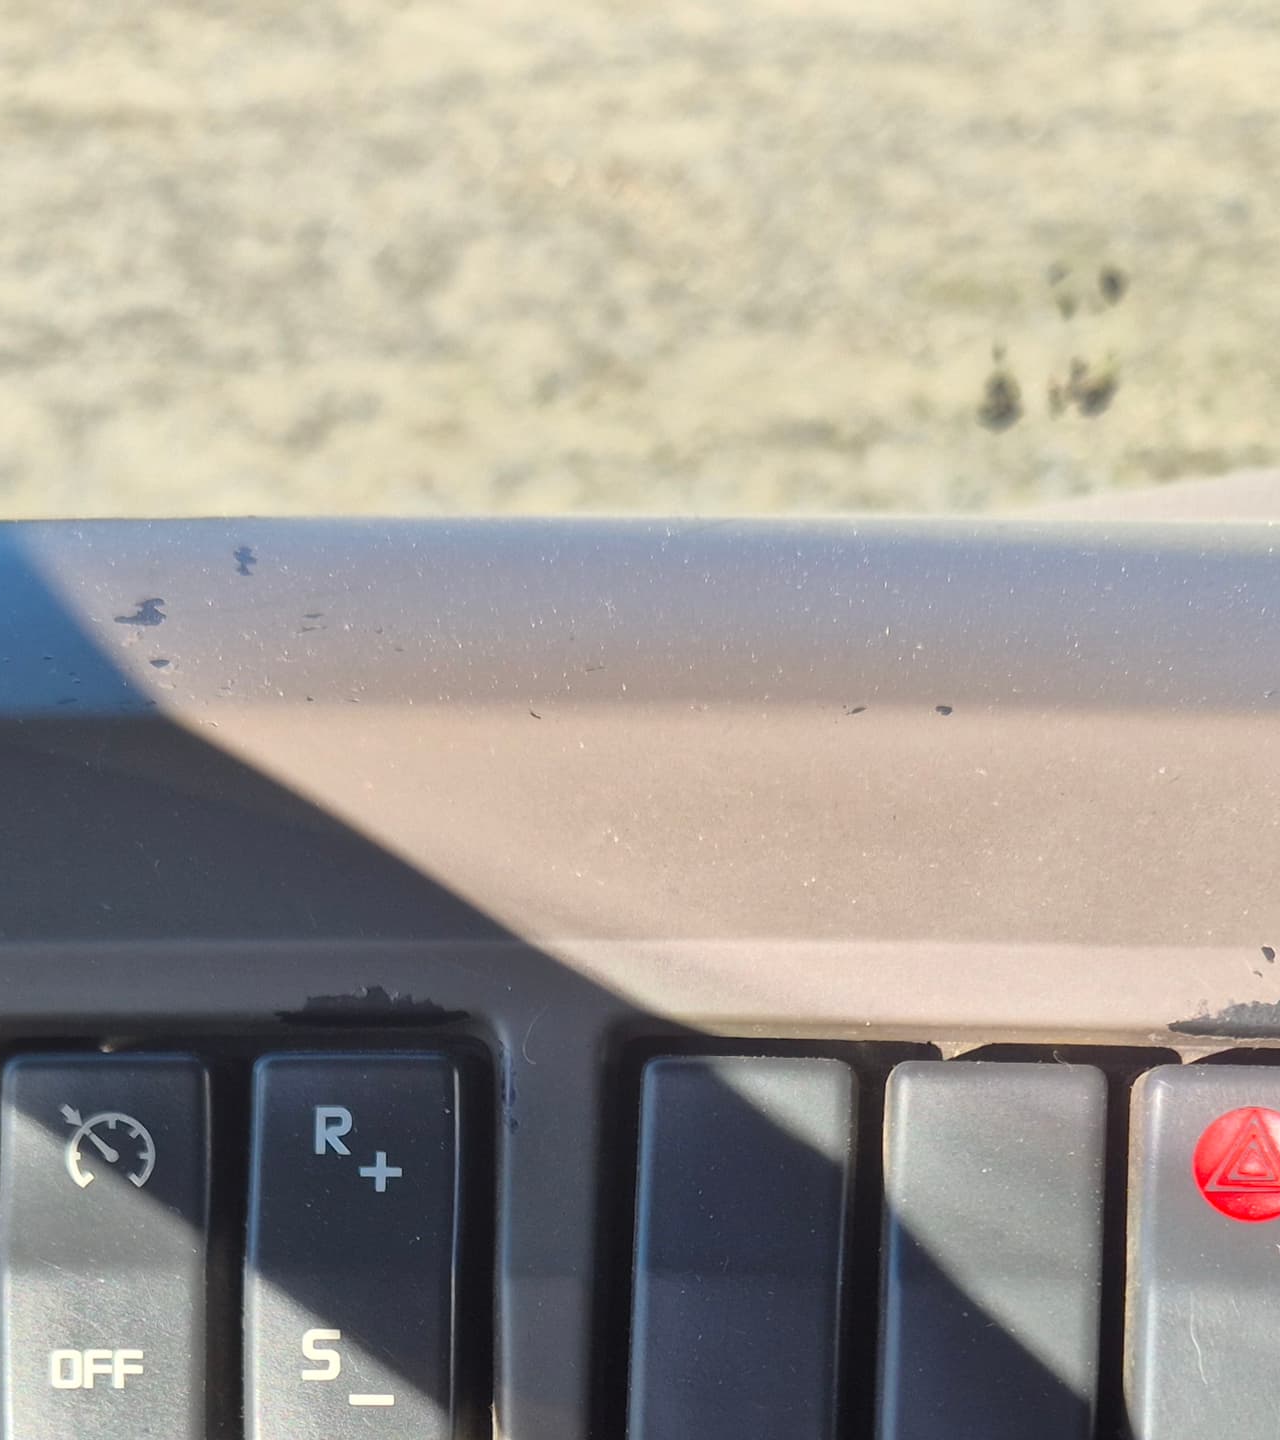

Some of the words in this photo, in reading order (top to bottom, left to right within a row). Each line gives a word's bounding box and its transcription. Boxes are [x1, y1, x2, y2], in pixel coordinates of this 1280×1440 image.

[314, 1106, 353, 1156] R
[51, 1349, 144, 1390] OFF
[301, 1329, 341, 1381] S
